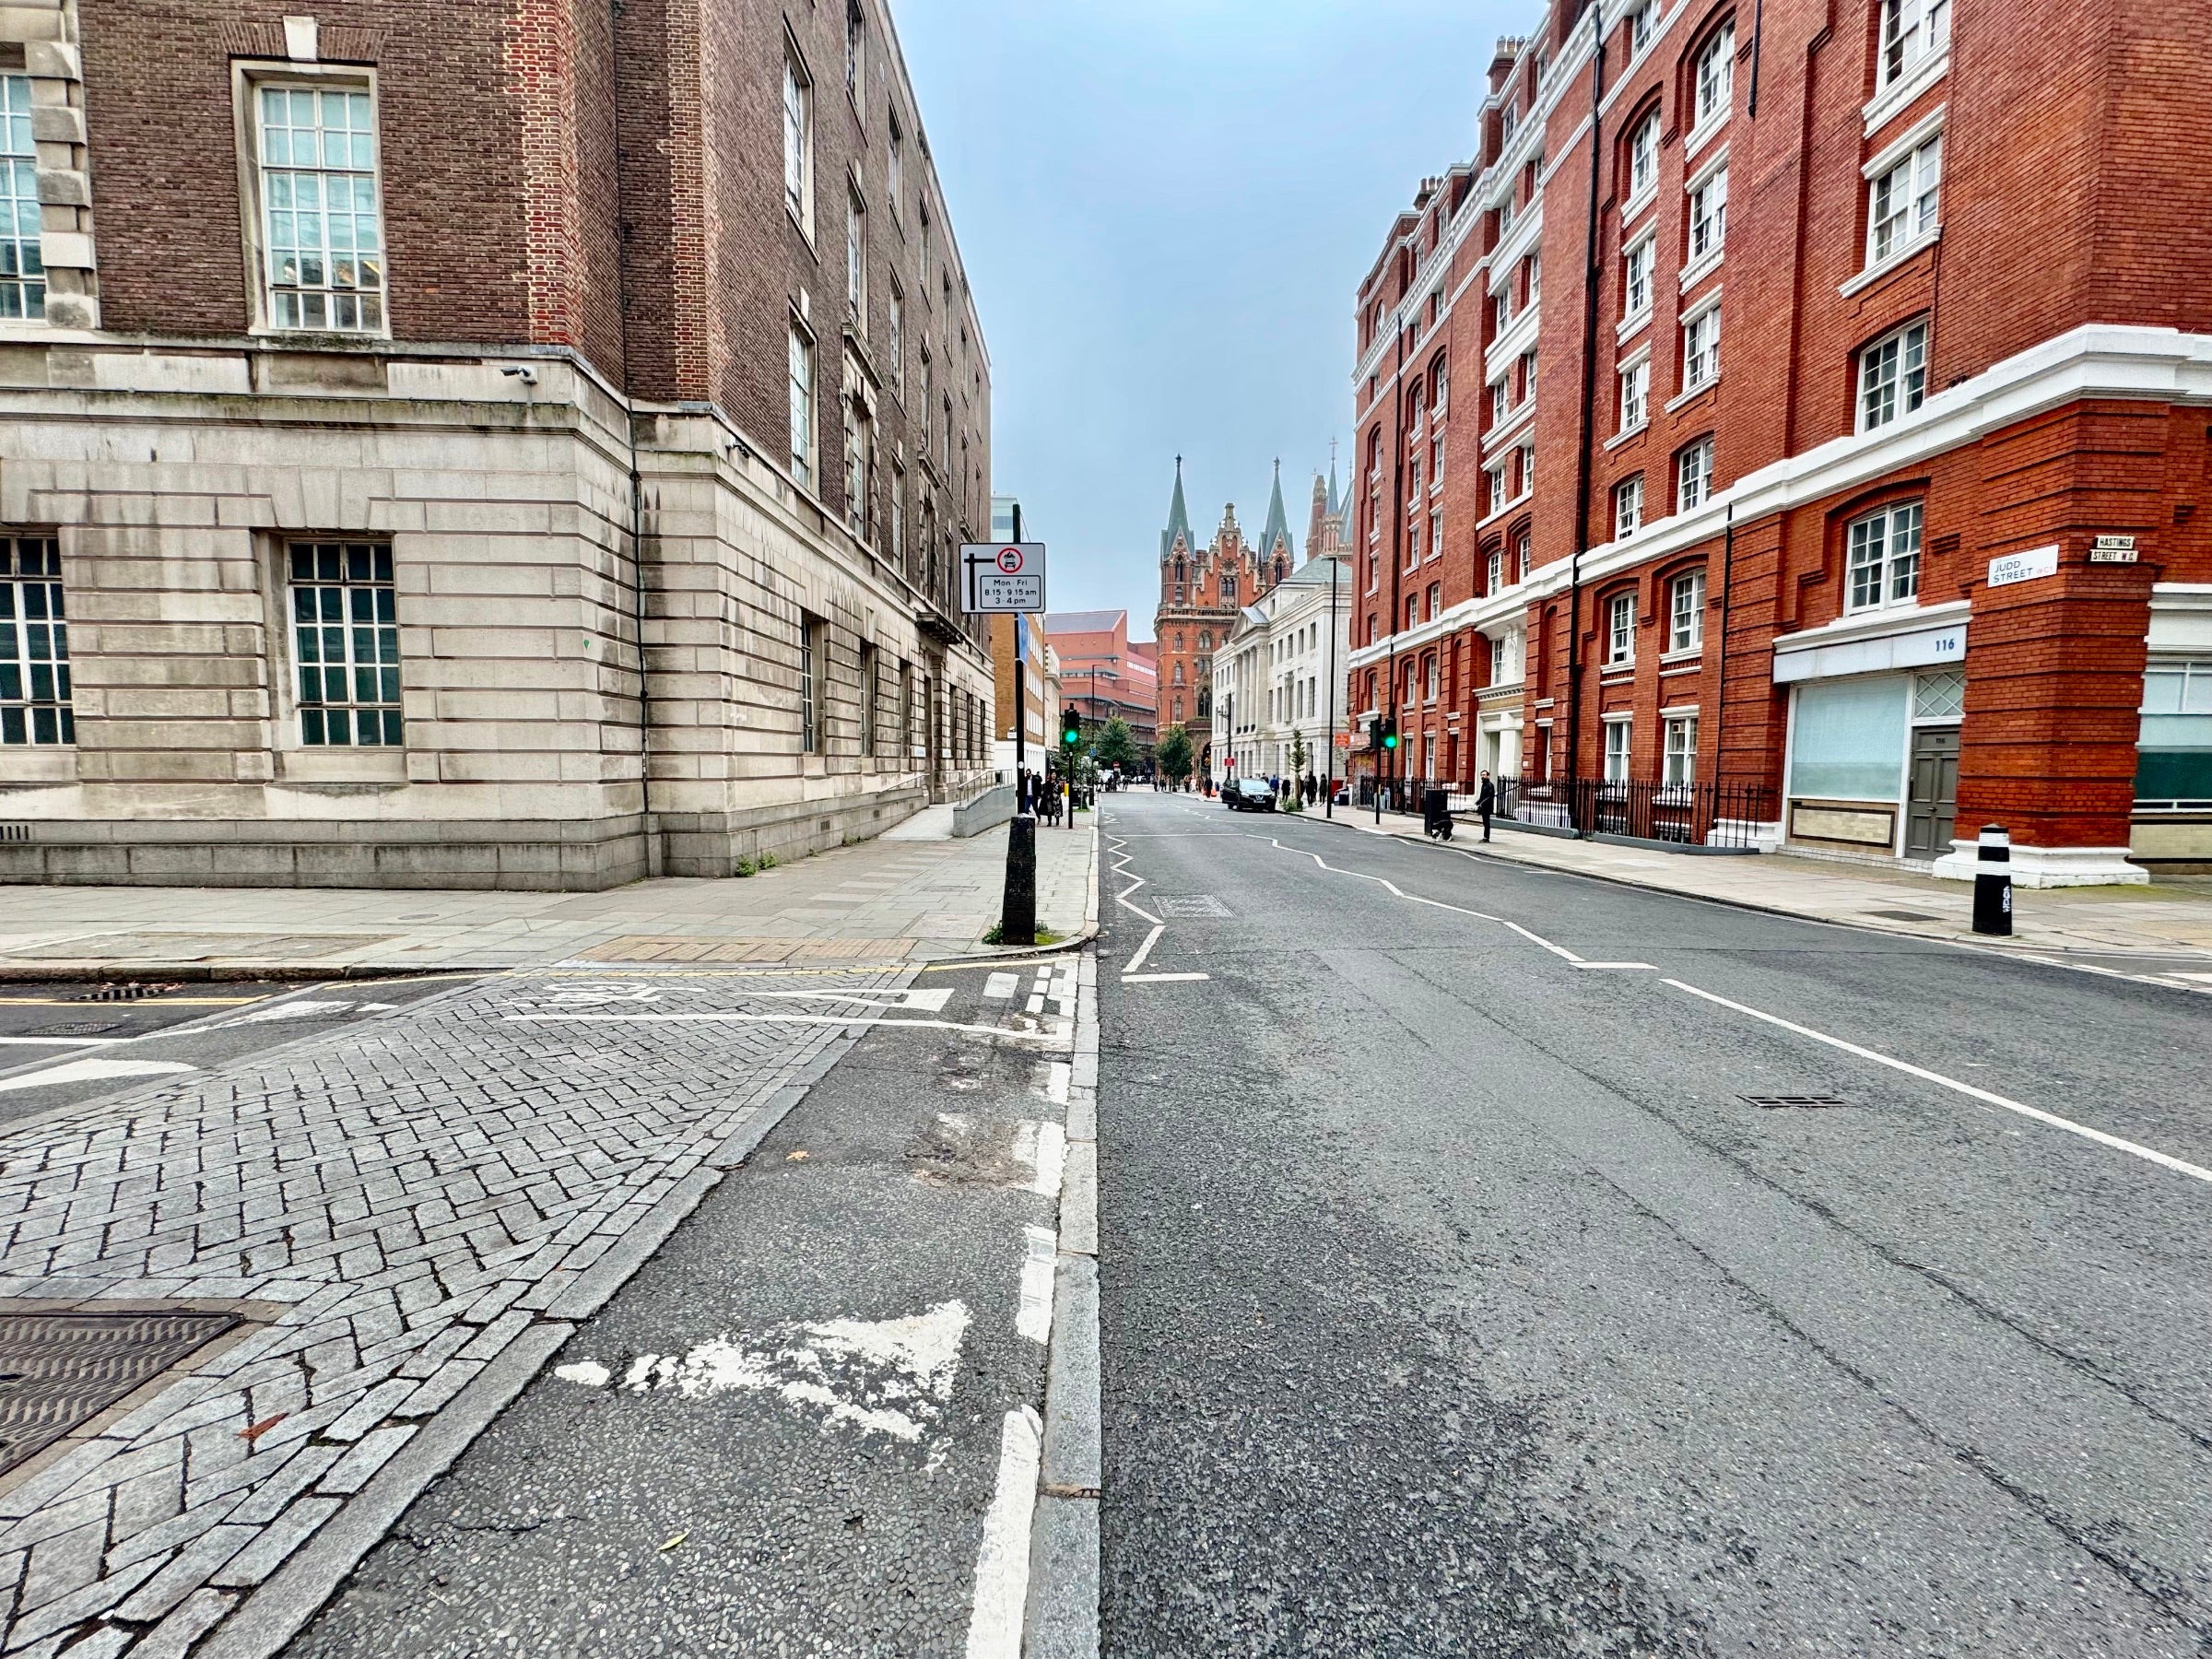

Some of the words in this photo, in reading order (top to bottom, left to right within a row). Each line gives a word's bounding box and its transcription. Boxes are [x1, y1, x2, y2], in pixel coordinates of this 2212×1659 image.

[2100, 537, 2131, 547] HASTINGS
[2093, 551, 2117, 560] STREET
[1994, 560, 2020, 573] JUDD
[1993, 567, 2033, 583] STREET
[2035, 566, 2053, 574] WC1
[1936, 638, 1955, 652] 116
